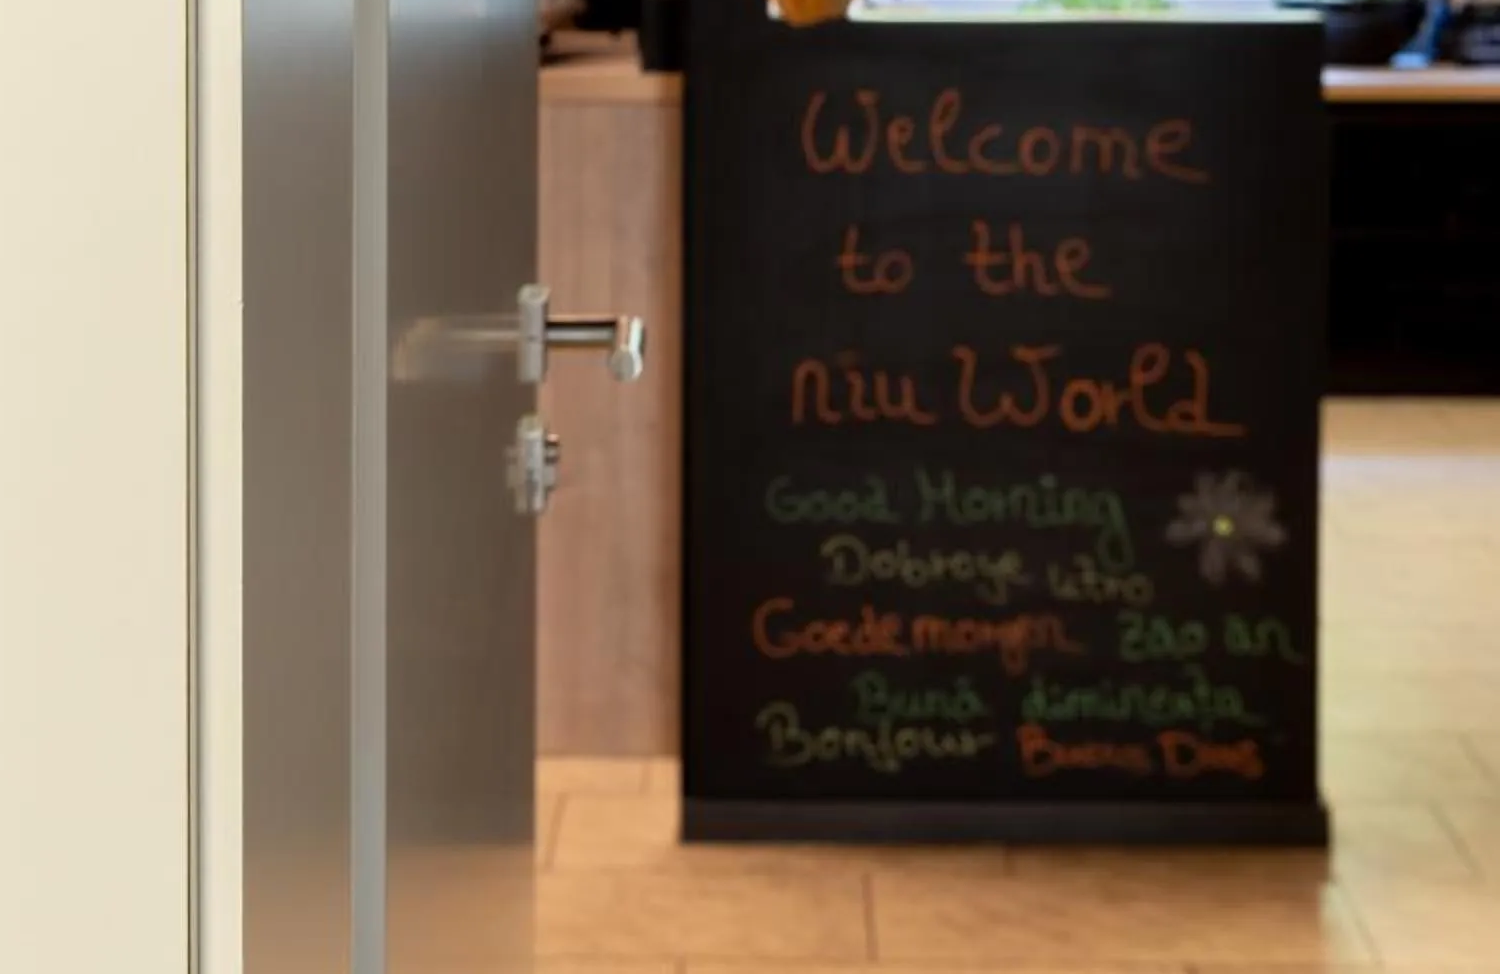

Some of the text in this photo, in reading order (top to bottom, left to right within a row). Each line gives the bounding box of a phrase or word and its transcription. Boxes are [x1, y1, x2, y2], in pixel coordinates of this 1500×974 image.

[801, 88, 1210, 183] Welcome
[837, 220, 1111, 298] to the
[792, 343, 1244, 437] niu World
[764, 466, 1136, 570] Good Morning
